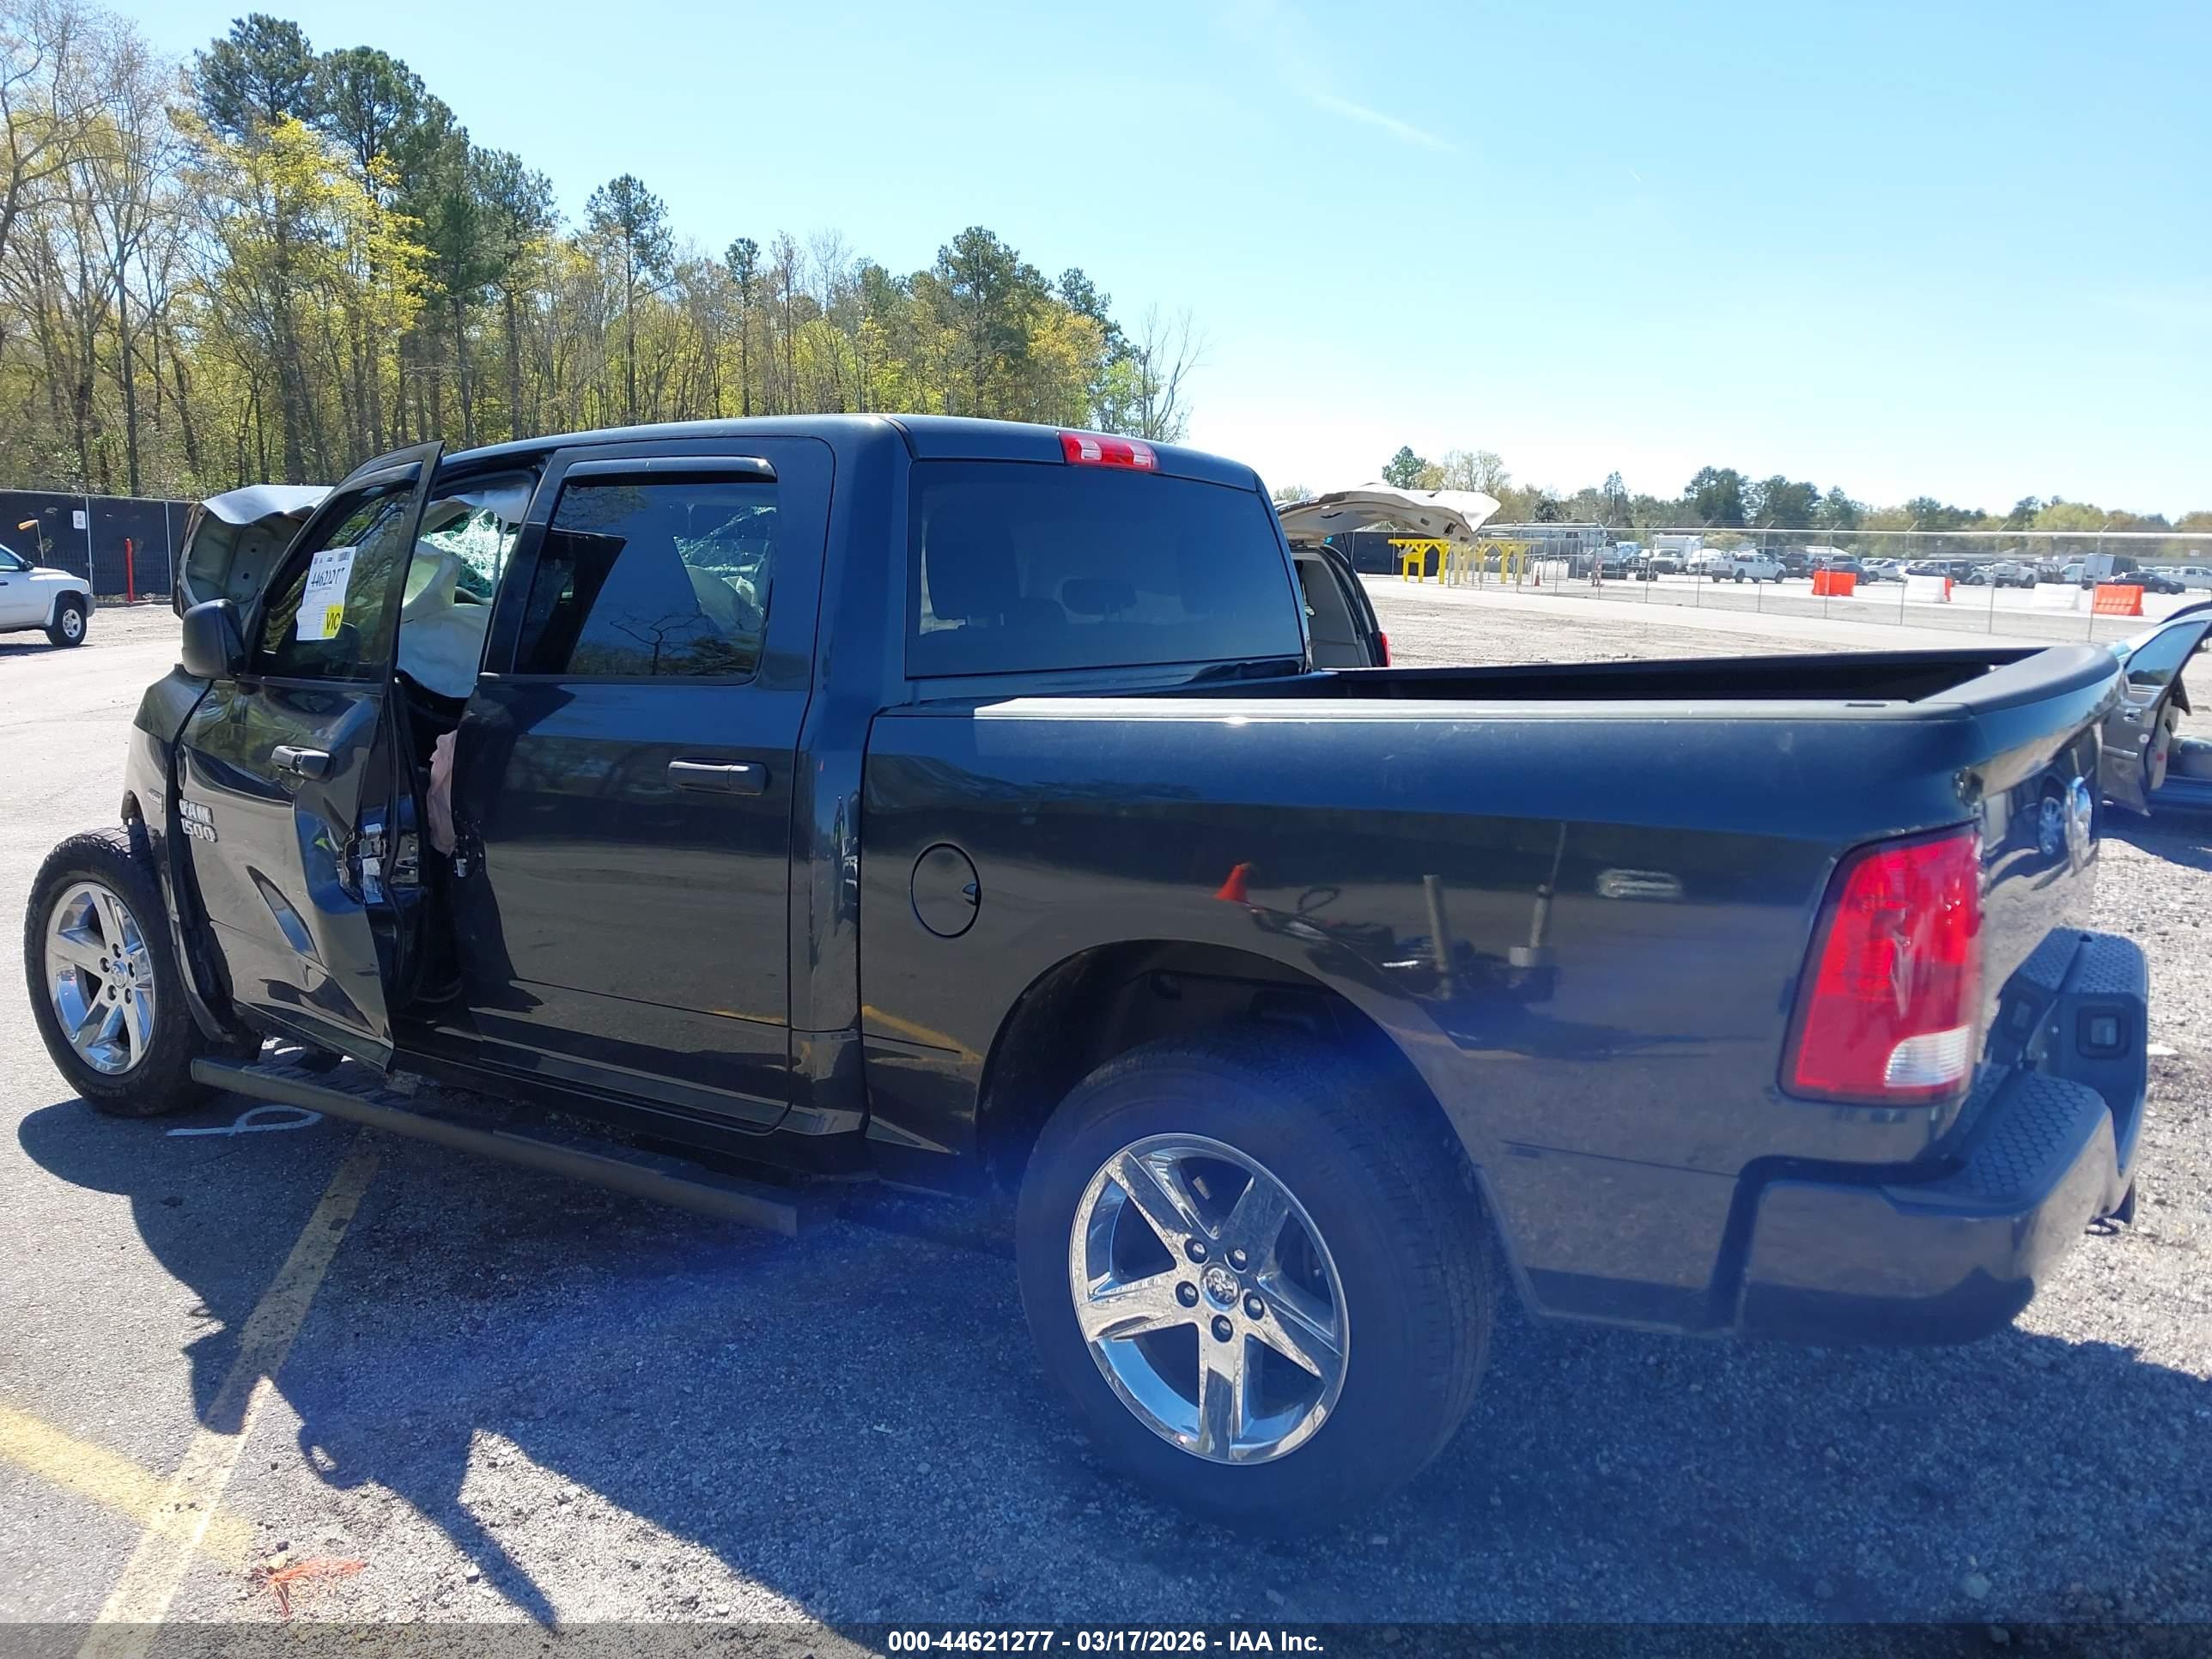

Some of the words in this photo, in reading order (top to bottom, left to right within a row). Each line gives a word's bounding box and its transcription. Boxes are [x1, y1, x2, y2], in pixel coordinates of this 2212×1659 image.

[325, 611, 341, 630] VIC
[179, 798, 212, 824] RAM
[180, 817, 218, 843] 1500
